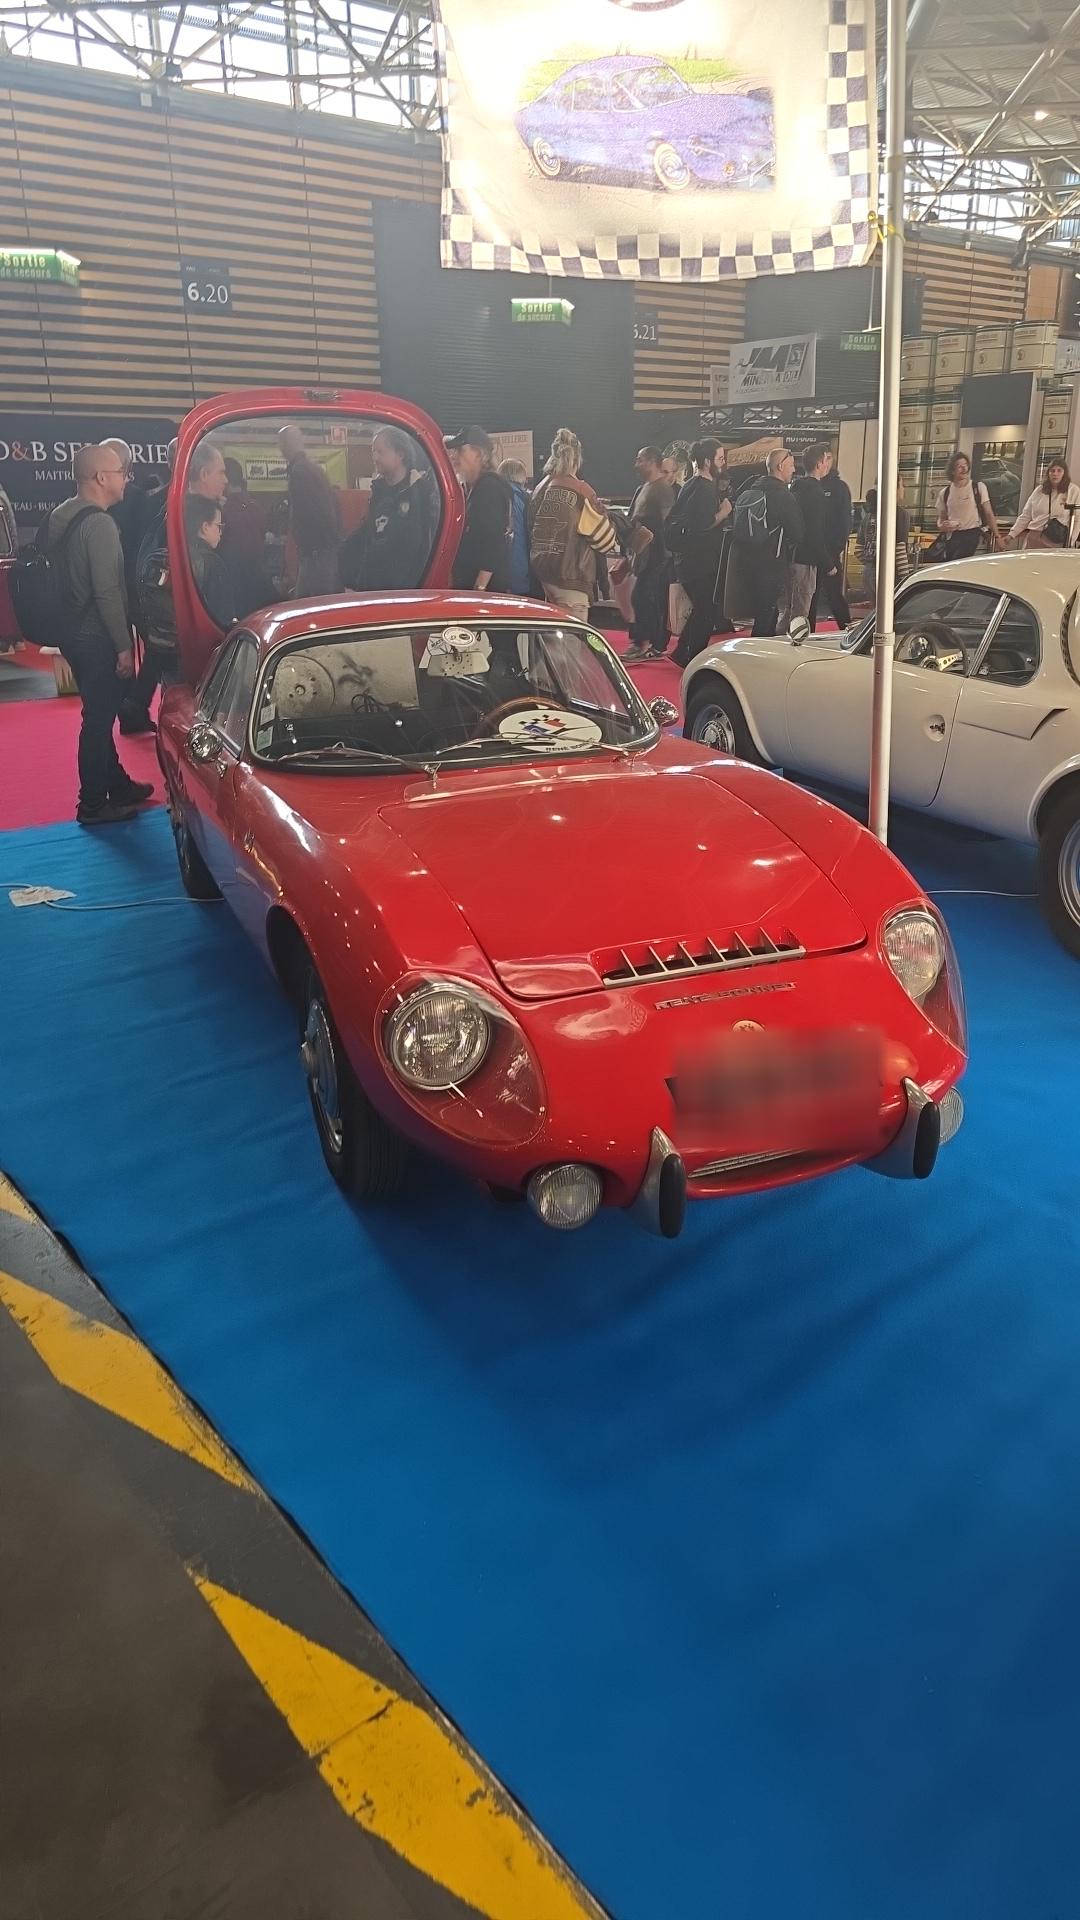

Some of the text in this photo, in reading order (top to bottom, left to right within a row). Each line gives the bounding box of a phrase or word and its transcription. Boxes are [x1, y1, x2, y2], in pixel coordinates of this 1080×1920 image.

[4, 253, 46, 268] Sortie
[187, 282, 229, 304] 6.20
[521, 303, 553, 313] Sortie
[848, 334, 876, 344] Sortie
[54, 441, 169, 464] SERIE
